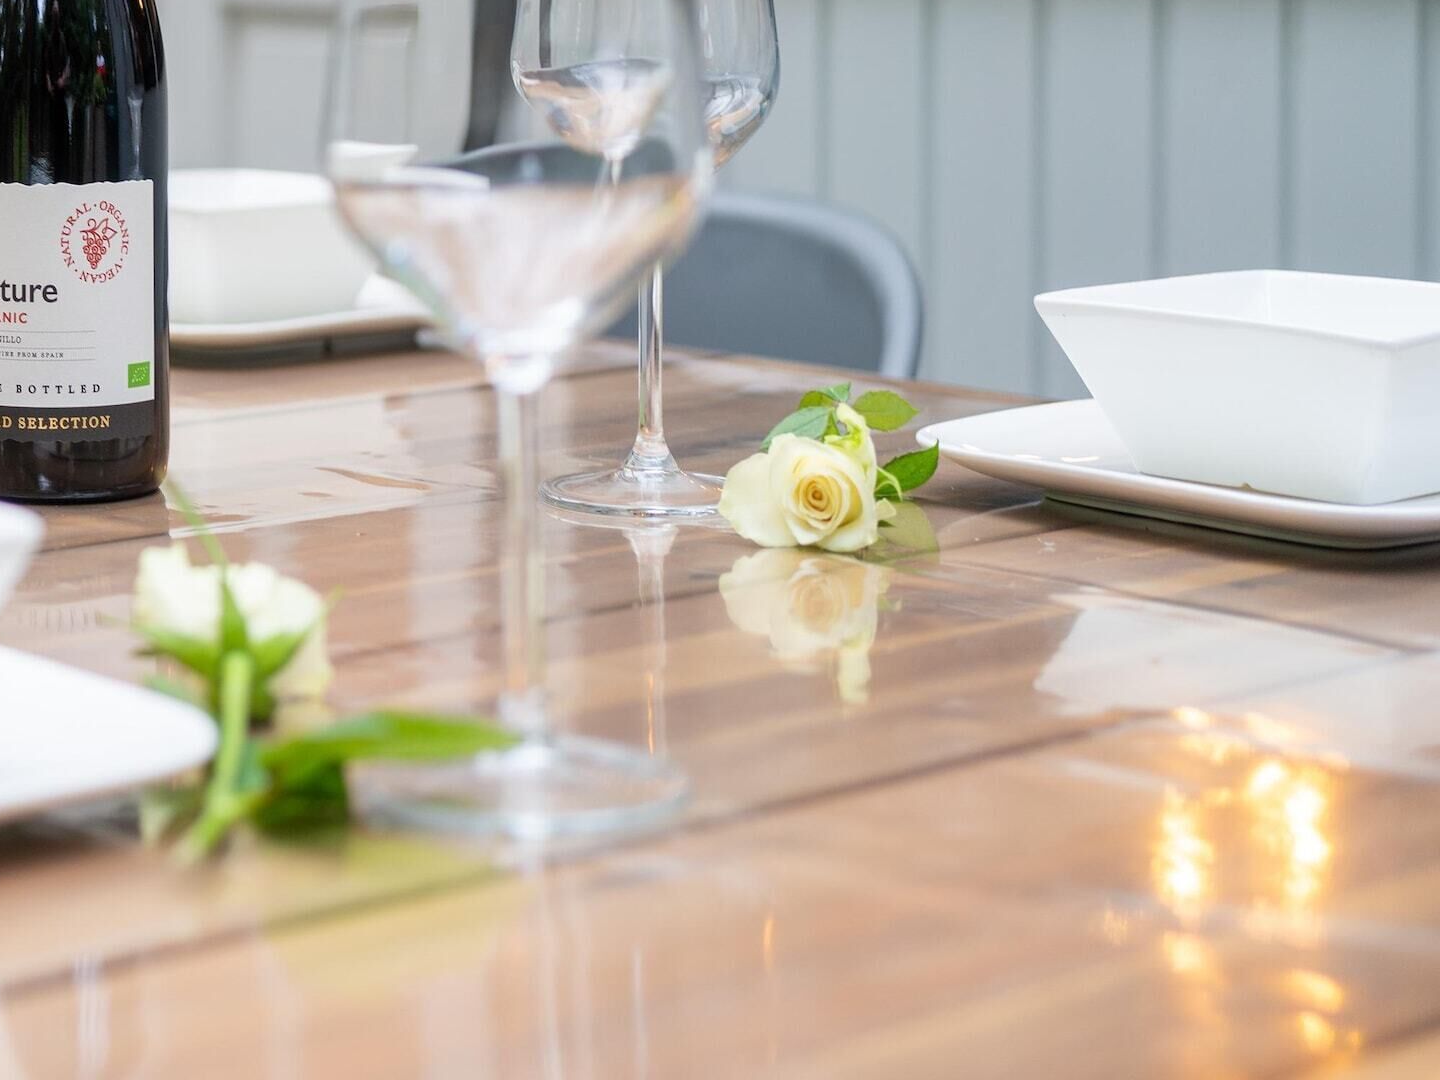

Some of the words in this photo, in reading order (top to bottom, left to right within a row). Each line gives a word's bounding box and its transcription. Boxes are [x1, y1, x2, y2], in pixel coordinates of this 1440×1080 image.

[60, 203, 91, 268] NATURAL
[100, 201, 129, 255] ORGANIC
[79, 263, 122, 284] VEGAN
[16, 383, 101, 395] BOTTLED
[18, 414, 110, 430] SELECTION
